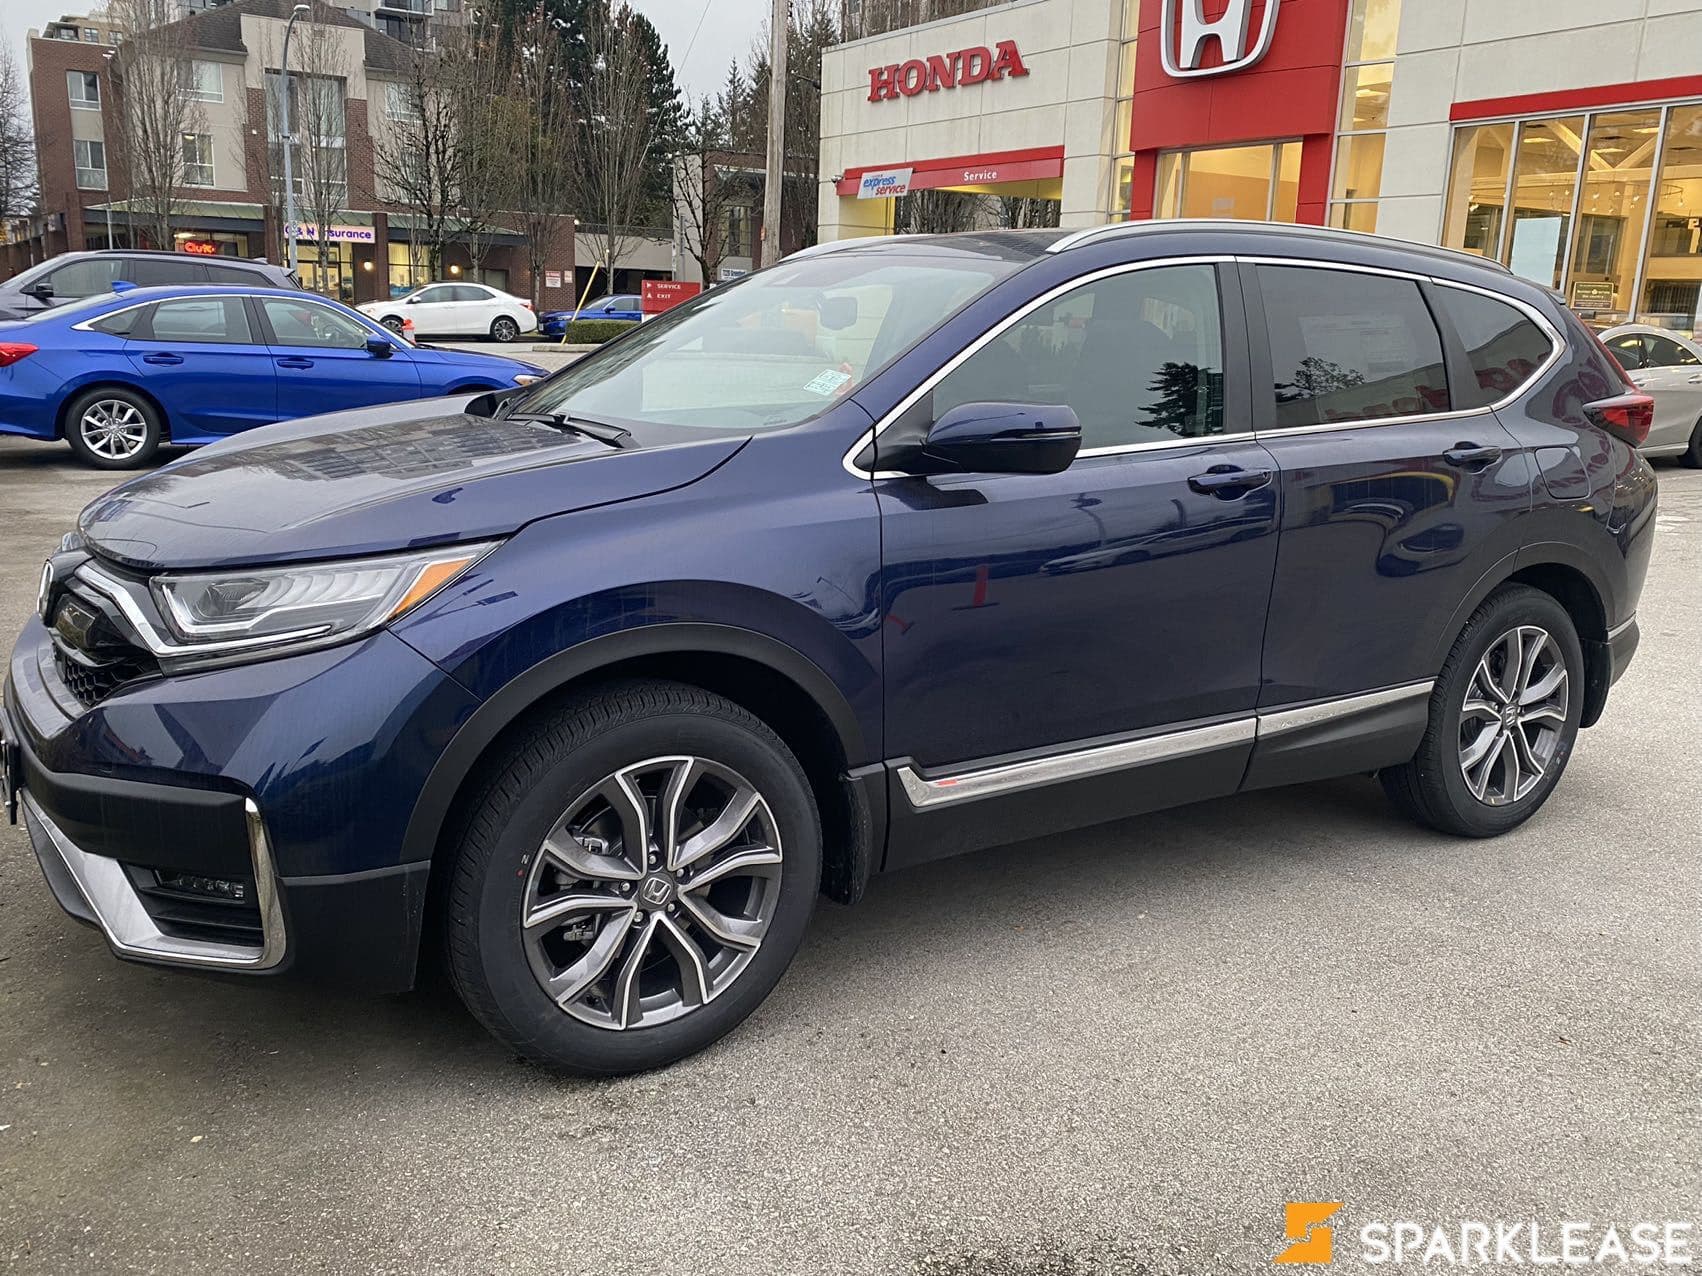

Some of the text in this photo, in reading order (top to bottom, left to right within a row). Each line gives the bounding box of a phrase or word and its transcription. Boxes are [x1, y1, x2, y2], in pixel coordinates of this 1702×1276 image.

[868, 40, 1030, 102] HONDA
[964, 169, 997, 181] Service
[864, 176, 896, 190] express
[875, 185, 905, 195] service
